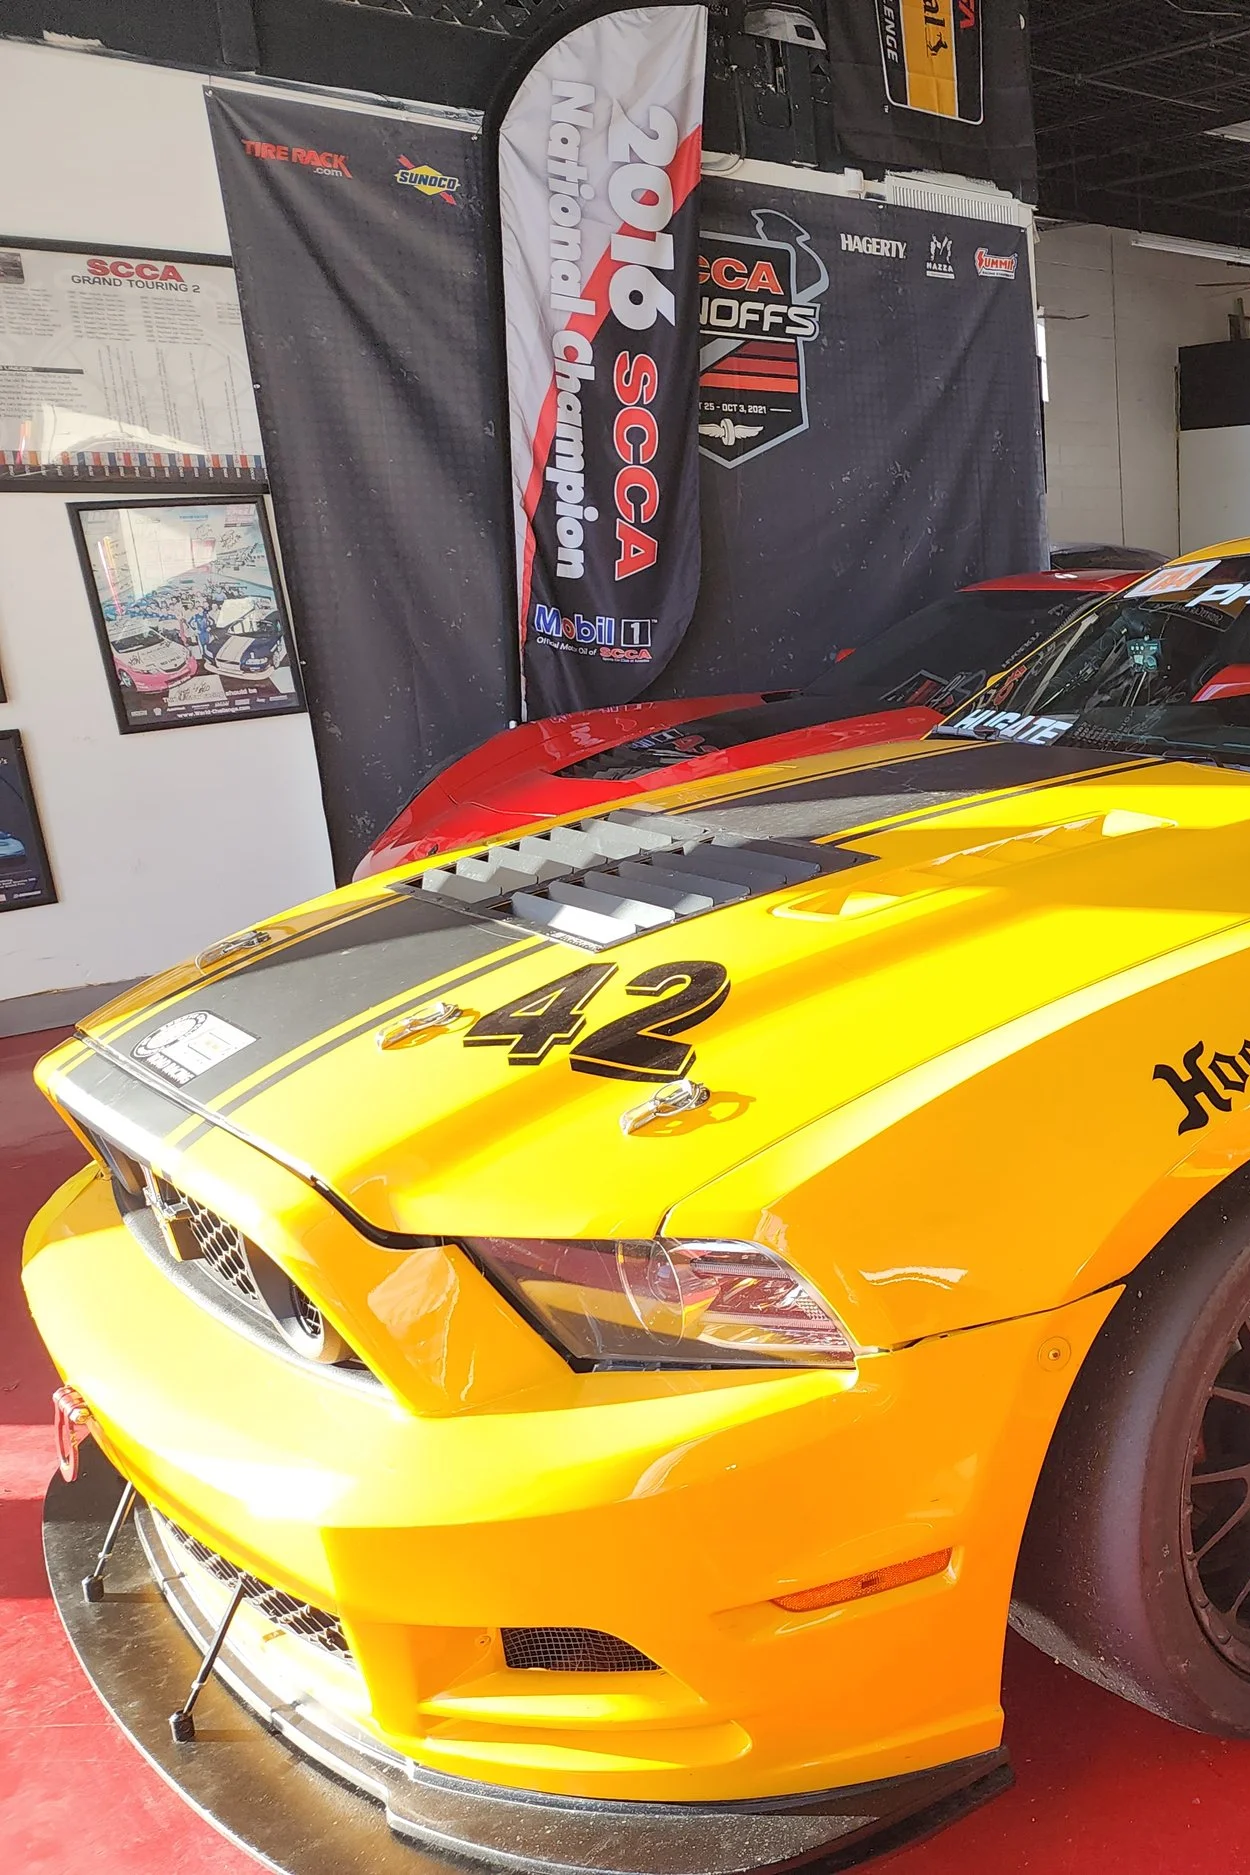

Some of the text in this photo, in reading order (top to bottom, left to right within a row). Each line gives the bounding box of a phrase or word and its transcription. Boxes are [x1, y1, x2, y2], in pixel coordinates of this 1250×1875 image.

[241, 139, 353, 179] TIRE RACK
[313, 167, 343, 177] .com
[399, 172, 457, 190] SUNOCO
[840, 233, 907, 259] HAGERTY
[87, 258, 185, 283] SCCA
[698, 254, 785, 296] CA
[71, 275, 201, 294] GRAND TOURING 2
[699, 296, 816, 336] OFFS
[545, 79, 598, 580] National Champion
[608, 104, 679, 581] 2016 SCCA
[704, 402, 715, 411] 25
[722, 403, 738, 413] OCT
[748, 405, 767, 414] 2021
[534, 603, 615, 646] Mobil
[578, 647, 588, 655] Oil
[588, 648, 597, 656] of
[600, 646, 652, 660] SCCA
[226, 689, 248, 697] should
[462, 960, 732, 1083] 42
